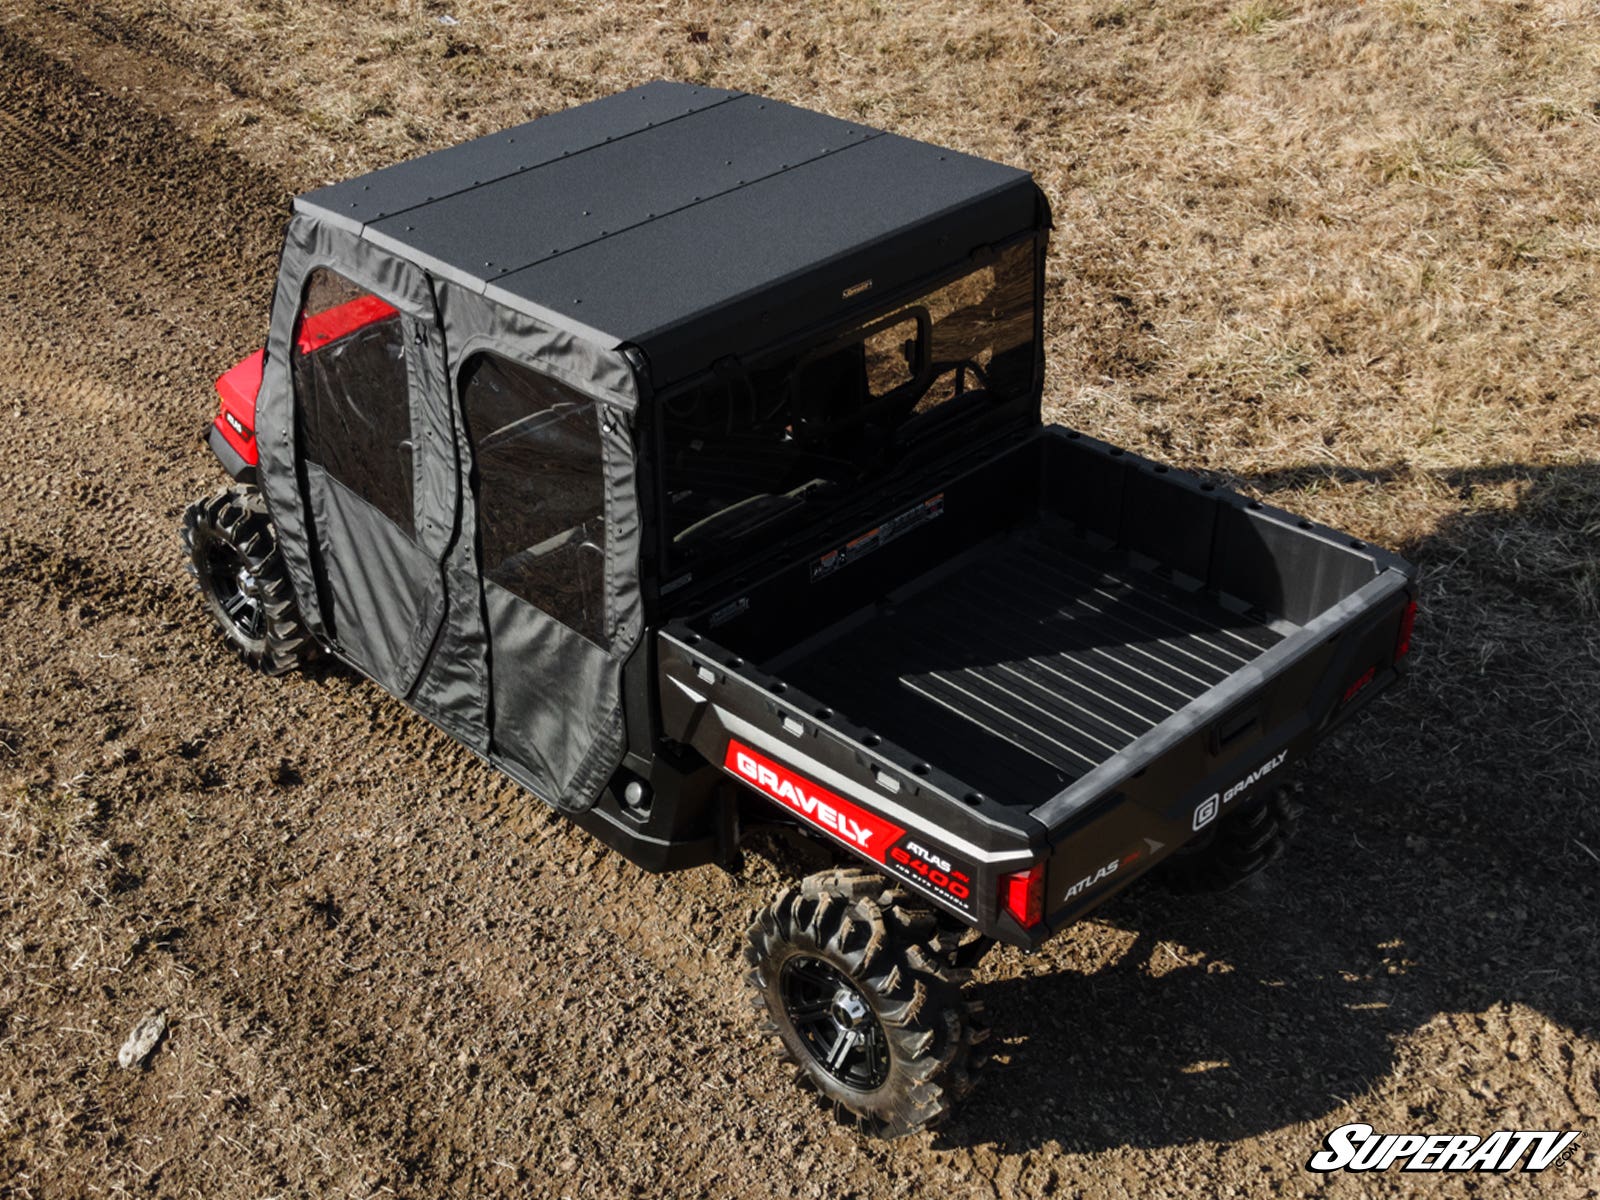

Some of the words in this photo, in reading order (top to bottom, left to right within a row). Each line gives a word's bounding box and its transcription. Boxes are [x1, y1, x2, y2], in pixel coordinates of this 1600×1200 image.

[736, 751, 873, 848] GRAVELY
[1223, 750, 1288, 803] GRAVELY
[906, 841, 952, 873] ATLAS
[1064, 859, 1119, 901] ATLAS
